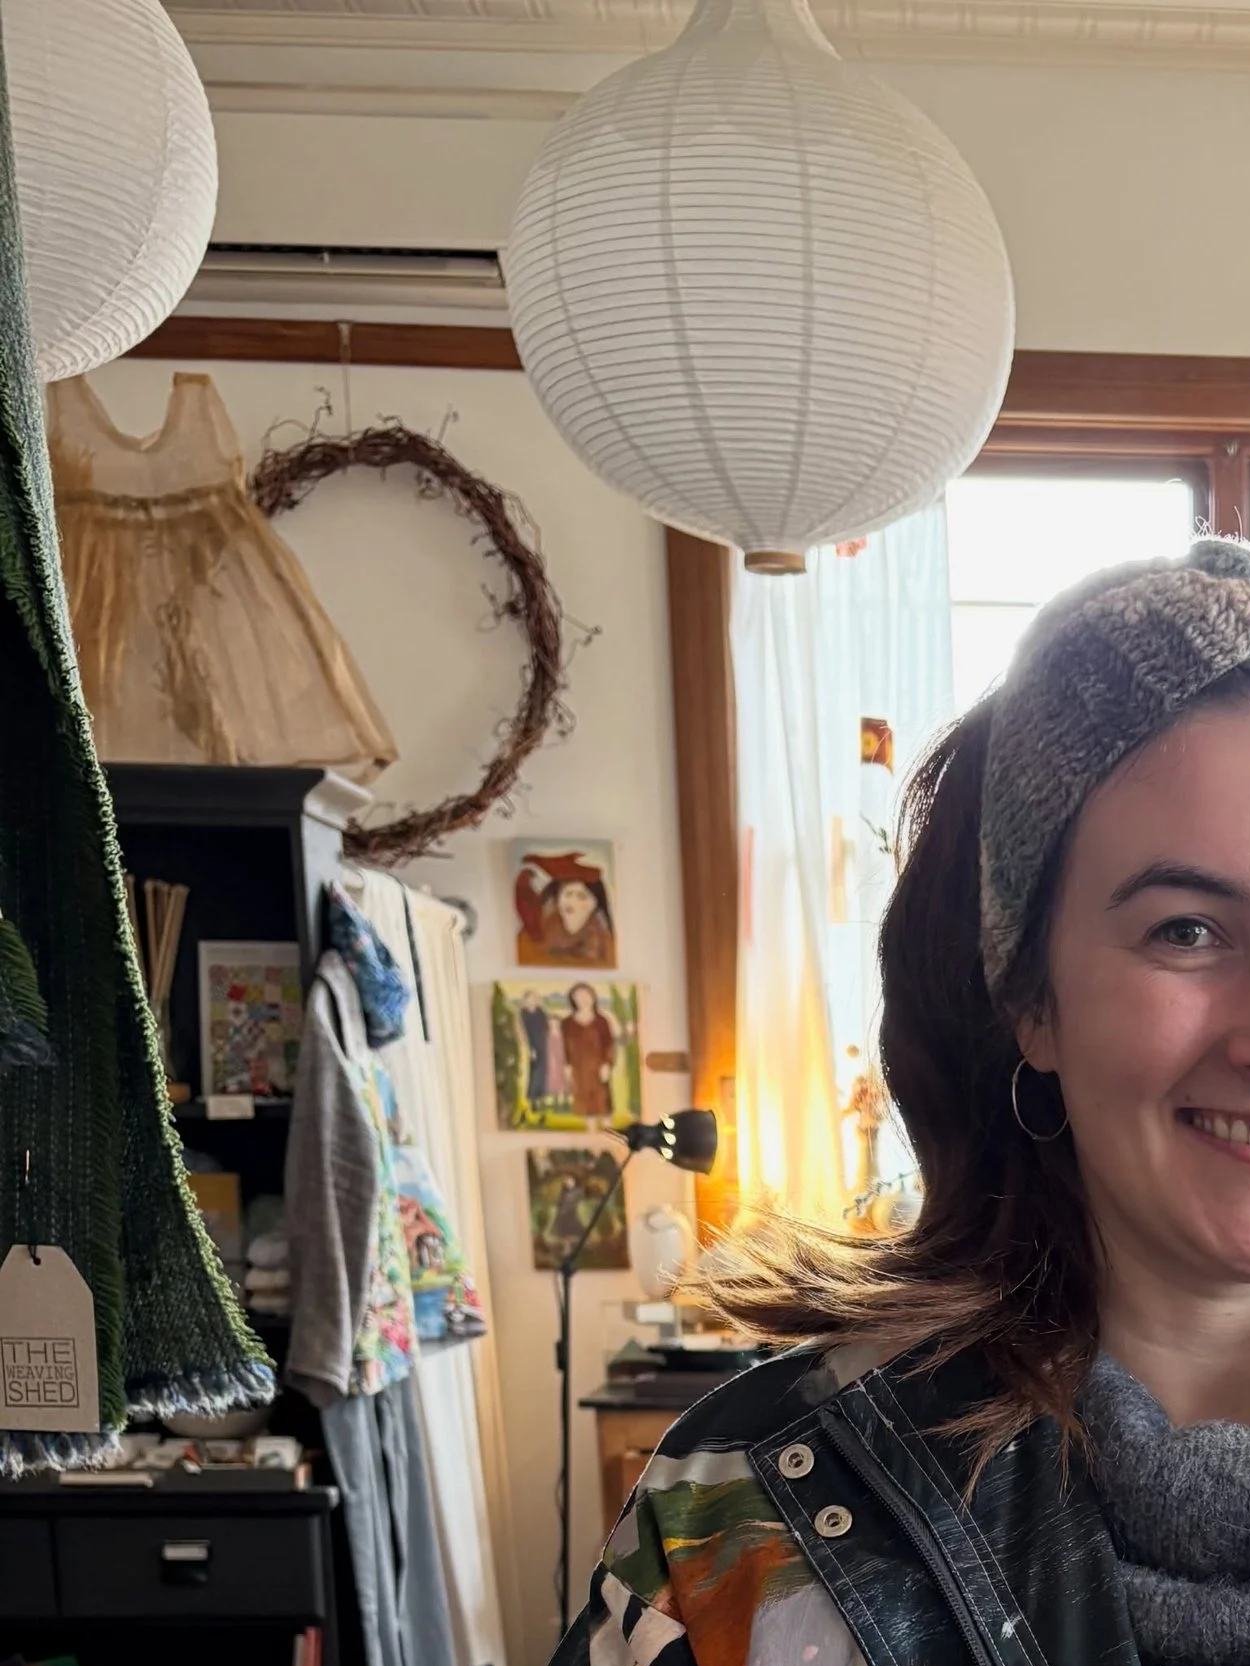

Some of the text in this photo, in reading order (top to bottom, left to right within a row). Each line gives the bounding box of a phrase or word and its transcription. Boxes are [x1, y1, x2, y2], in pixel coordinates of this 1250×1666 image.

[3, 1341, 72, 1363] THE
[6, 1365, 74, 1380] WEAVING
[8, 1380, 75, 1402] SHED
